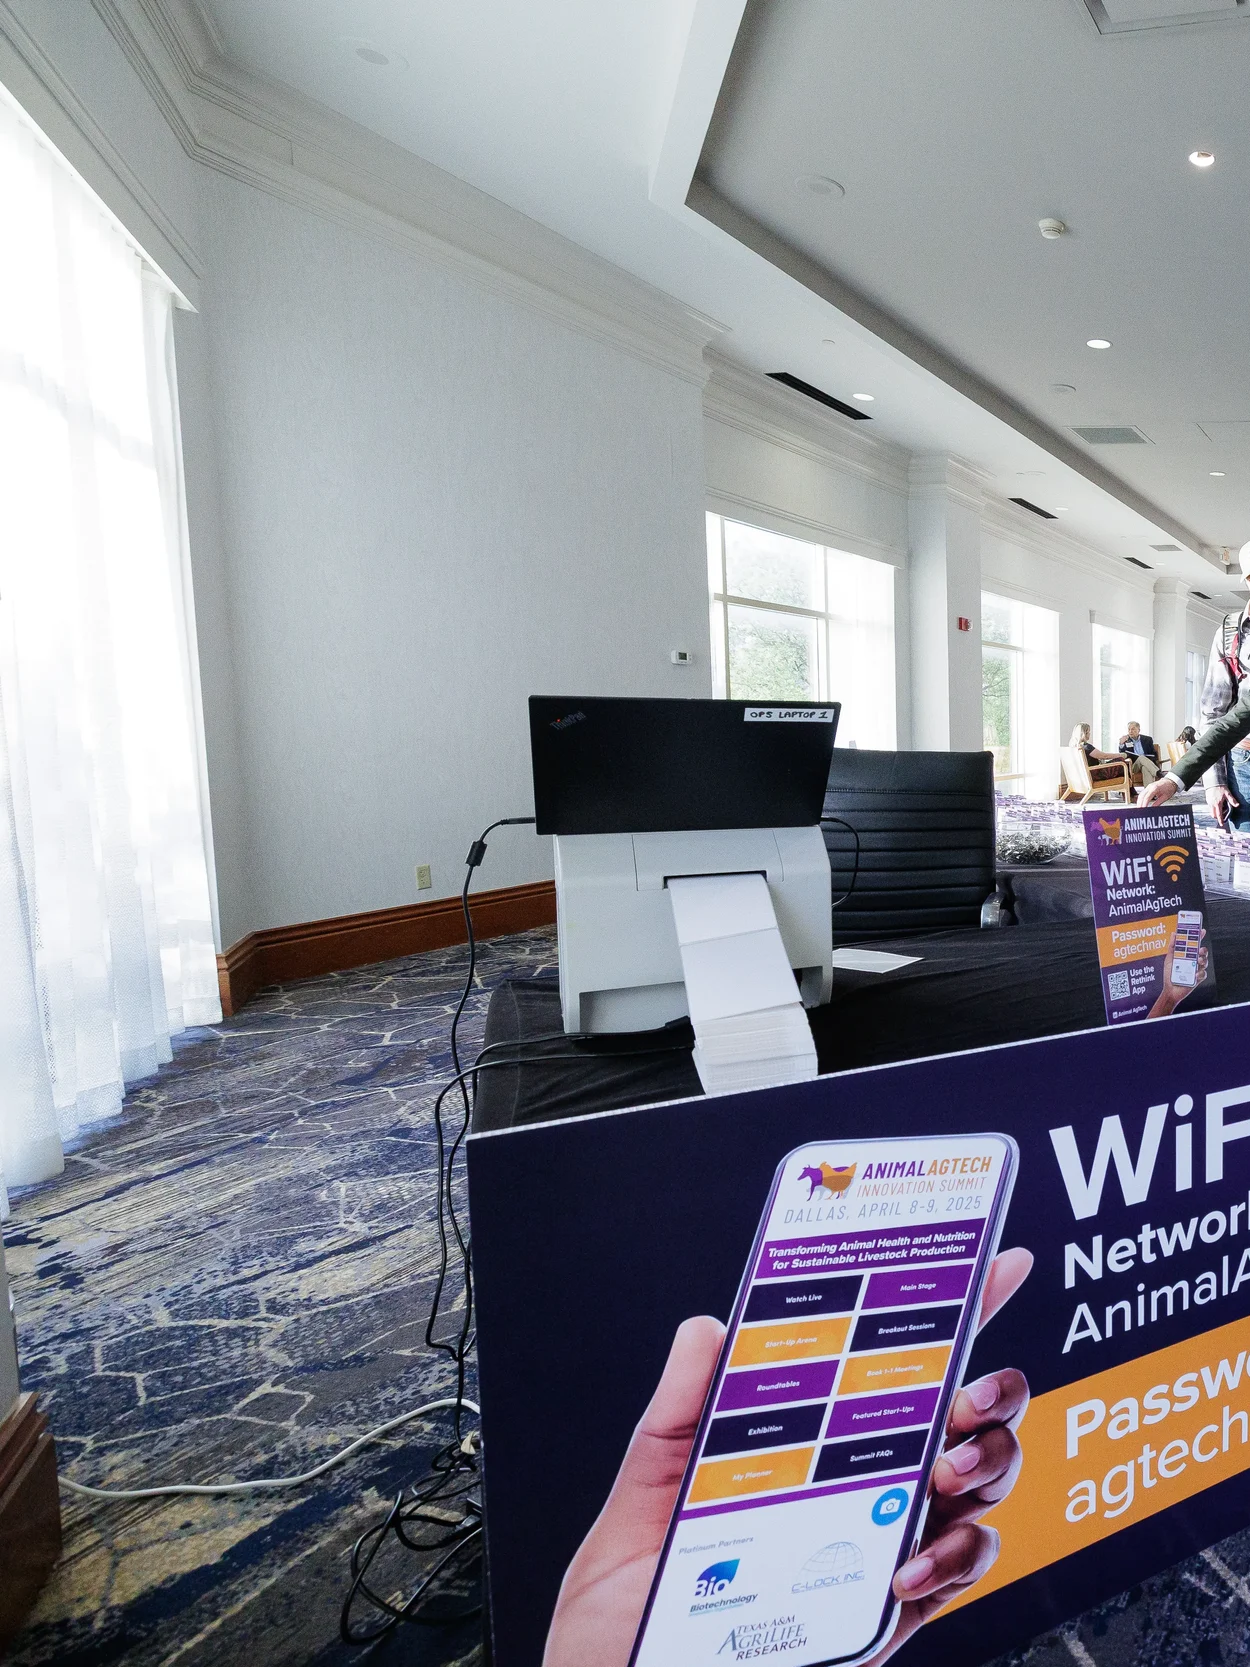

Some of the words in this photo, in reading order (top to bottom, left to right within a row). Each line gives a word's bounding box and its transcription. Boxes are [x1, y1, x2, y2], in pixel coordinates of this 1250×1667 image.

[750, 711, 772, 719] OPS
[778, 711, 816, 719] LAPTOP
[817, 711, 829, 719] 1
[1124, 814, 1191, 831] ANIMALAGTECH
[1125, 830, 1166, 843] INNOVATION
[1167, 828, 1192, 839] SUMMIT
[1100, 855, 1154, 886] WiFi
[1106, 883, 1156, 901] Network:
[1108, 894, 1183, 918] AnimalAgTech
[1111, 922, 1167, 943] Password:
[1113, 938, 1167, 960] agtechnav
[1130, 968, 1143, 976] Use
[1143, 965, 1155, 974] the
[1131, 973, 1156, 985] Rethink
[1132, 986, 1146, 996] App
[861, 1156, 993, 1180] ANIMALAGTECH
[857, 1180, 935, 1198] INNOVATION
[939, 1176, 988, 1192] SUMMIT
[783, 1205, 850, 1224] DALLAS,
[857, 1201, 902, 1219] APRIL
[909, 1198, 938, 1215] 8-9,
[945, 1195, 983, 1211] 2025
[768, 1243, 837, 1258] Transforming
[838, 1239, 876, 1252] Animal
[877, 1236, 911, 1248] Health
[912, 1234, 932, 1246] and
[933, 1230, 976, 1243] Nutrition
[772, 1258, 789, 1271] for
[791, 1253, 856, 1269] Sustainable
[858, 1250, 908, 1263] Livestock
[909, 1244, 966, 1257] Production
[900, 1284, 917, 1292] Main
[917, 1282, 937, 1291] Stage
[785, 1295, 808, 1304] Watch
[878, 1325, 908, 1335] Breakout
[908, 1322, 936, 1332] Sessions
[764, 1339, 796, 1348] Start-Up
[796, 1336, 818, 1344] Arena
[866, 1368, 883, 1377] Book
[894, 1364, 924, 1374] Meetings
[756, 1380, 800, 1391] Roundtables
[852, 1410, 882, 1420] Featured
[883, 1406, 915, 1416] Start-Ups
[748, 1425, 783, 1436] Exhibition
[849, 1453, 875, 1462] Summit
[875, 1449, 894, 1459] FAQs
[746, 1469, 773, 1478] Planner
[678, 1543, 716, 1555] Platinum
[718, 1537, 754, 1548] Partners
[791, 1575, 841, 1593] C-LOCK
[689, 1592, 759, 1613] Biotechnology
[736, 1621, 768, 1635] TEXAS
[771, 1614, 796, 1626] A&M
[735, 1636, 808, 1661] RESEARCH
